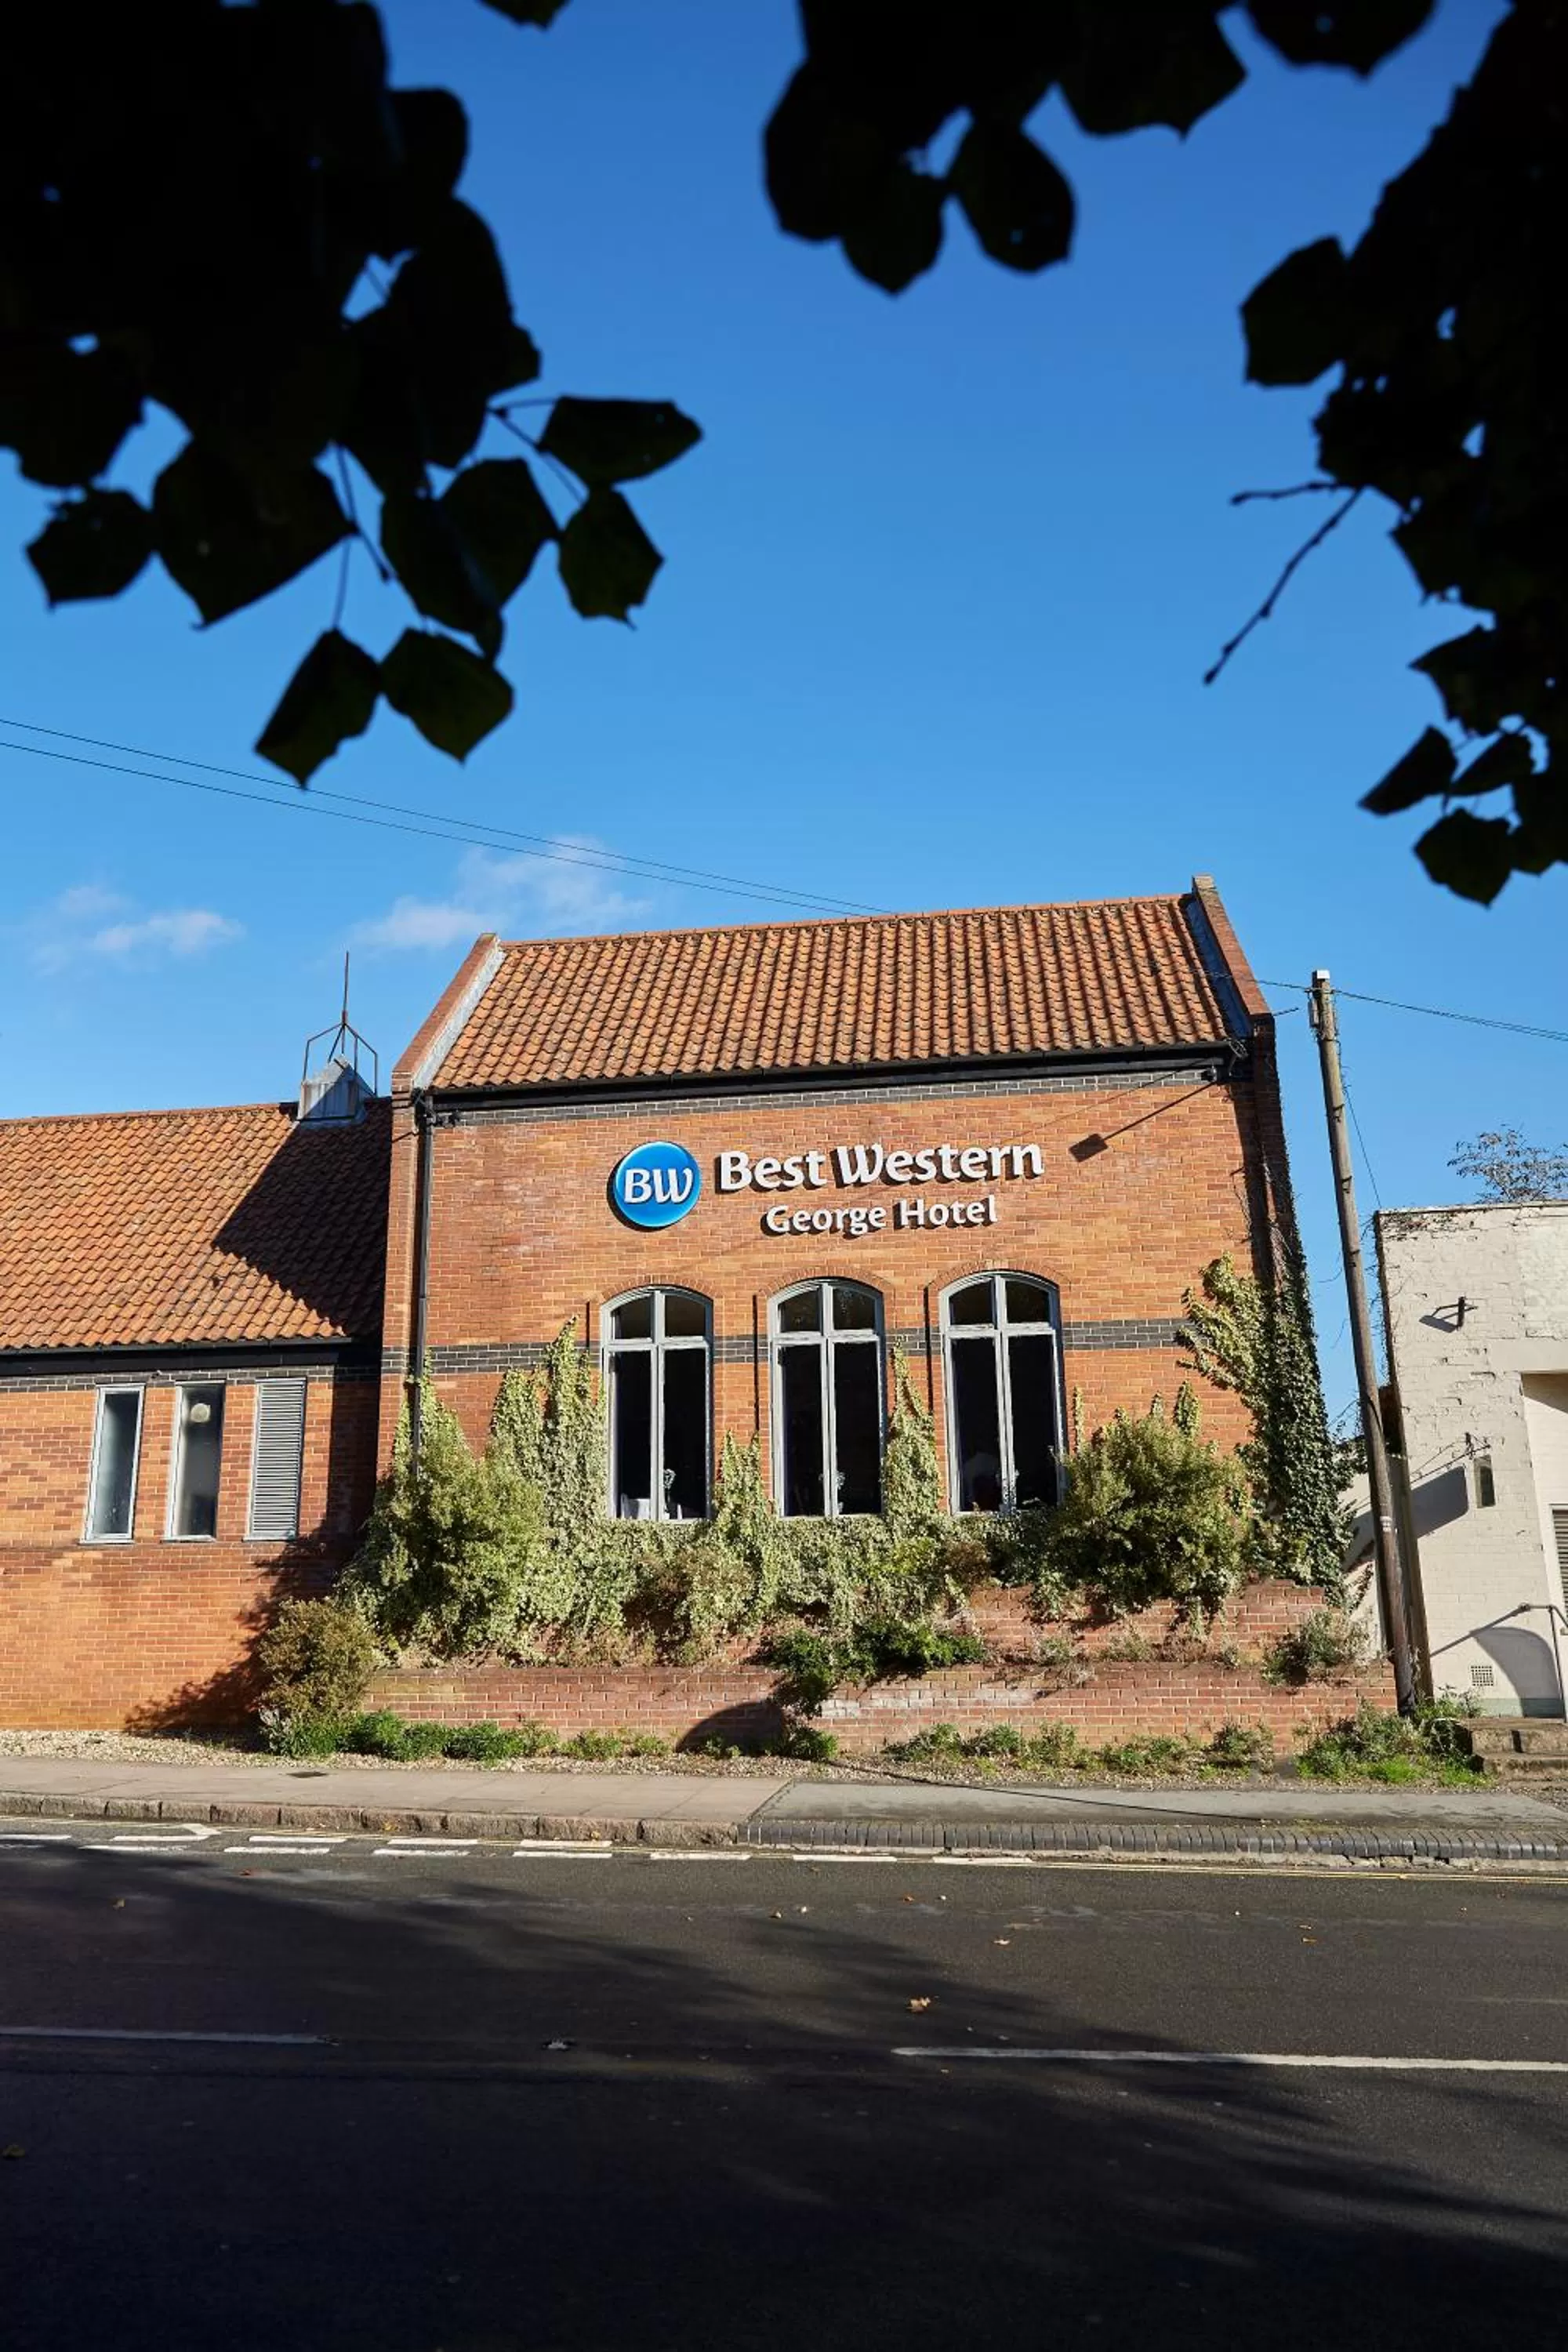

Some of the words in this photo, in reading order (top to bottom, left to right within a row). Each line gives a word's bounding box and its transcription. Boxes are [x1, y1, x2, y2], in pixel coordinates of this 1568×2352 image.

[624, 1167, 693, 1203] BW
[720, 1149, 826, 1191] Best
[837, 1143, 1044, 1185] Western
[766, 1203, 887, 1236] George
[901, 1195, 998, 1226] Hotel
